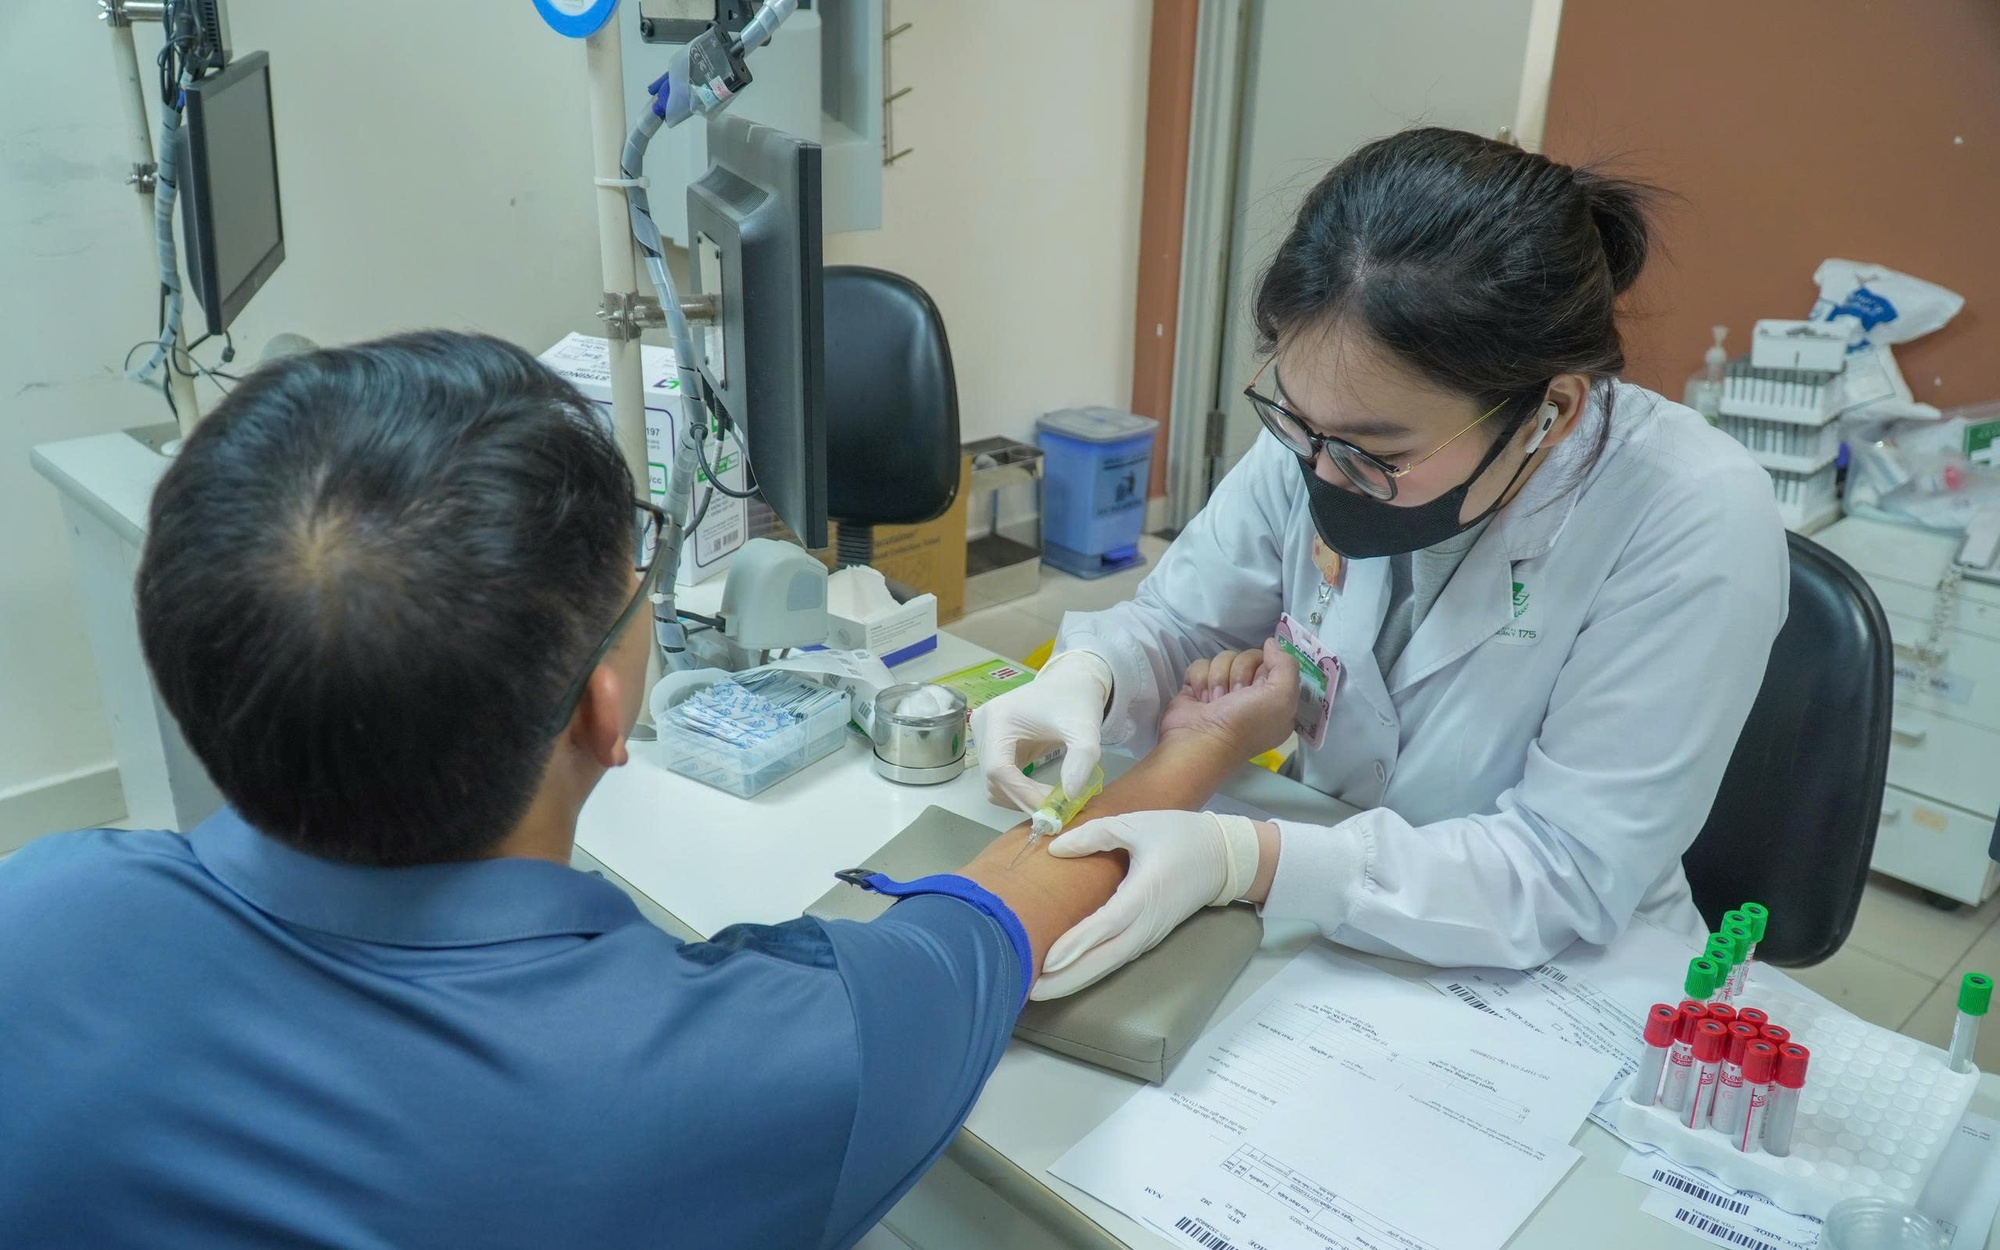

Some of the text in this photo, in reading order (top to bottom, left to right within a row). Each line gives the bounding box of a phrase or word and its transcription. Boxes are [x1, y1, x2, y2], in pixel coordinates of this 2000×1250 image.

[1518, 628, 1536, 639] 175
[1144, 1185, 1163, 1199] NAM
[1200, 1196, 1212, 1206] 202
